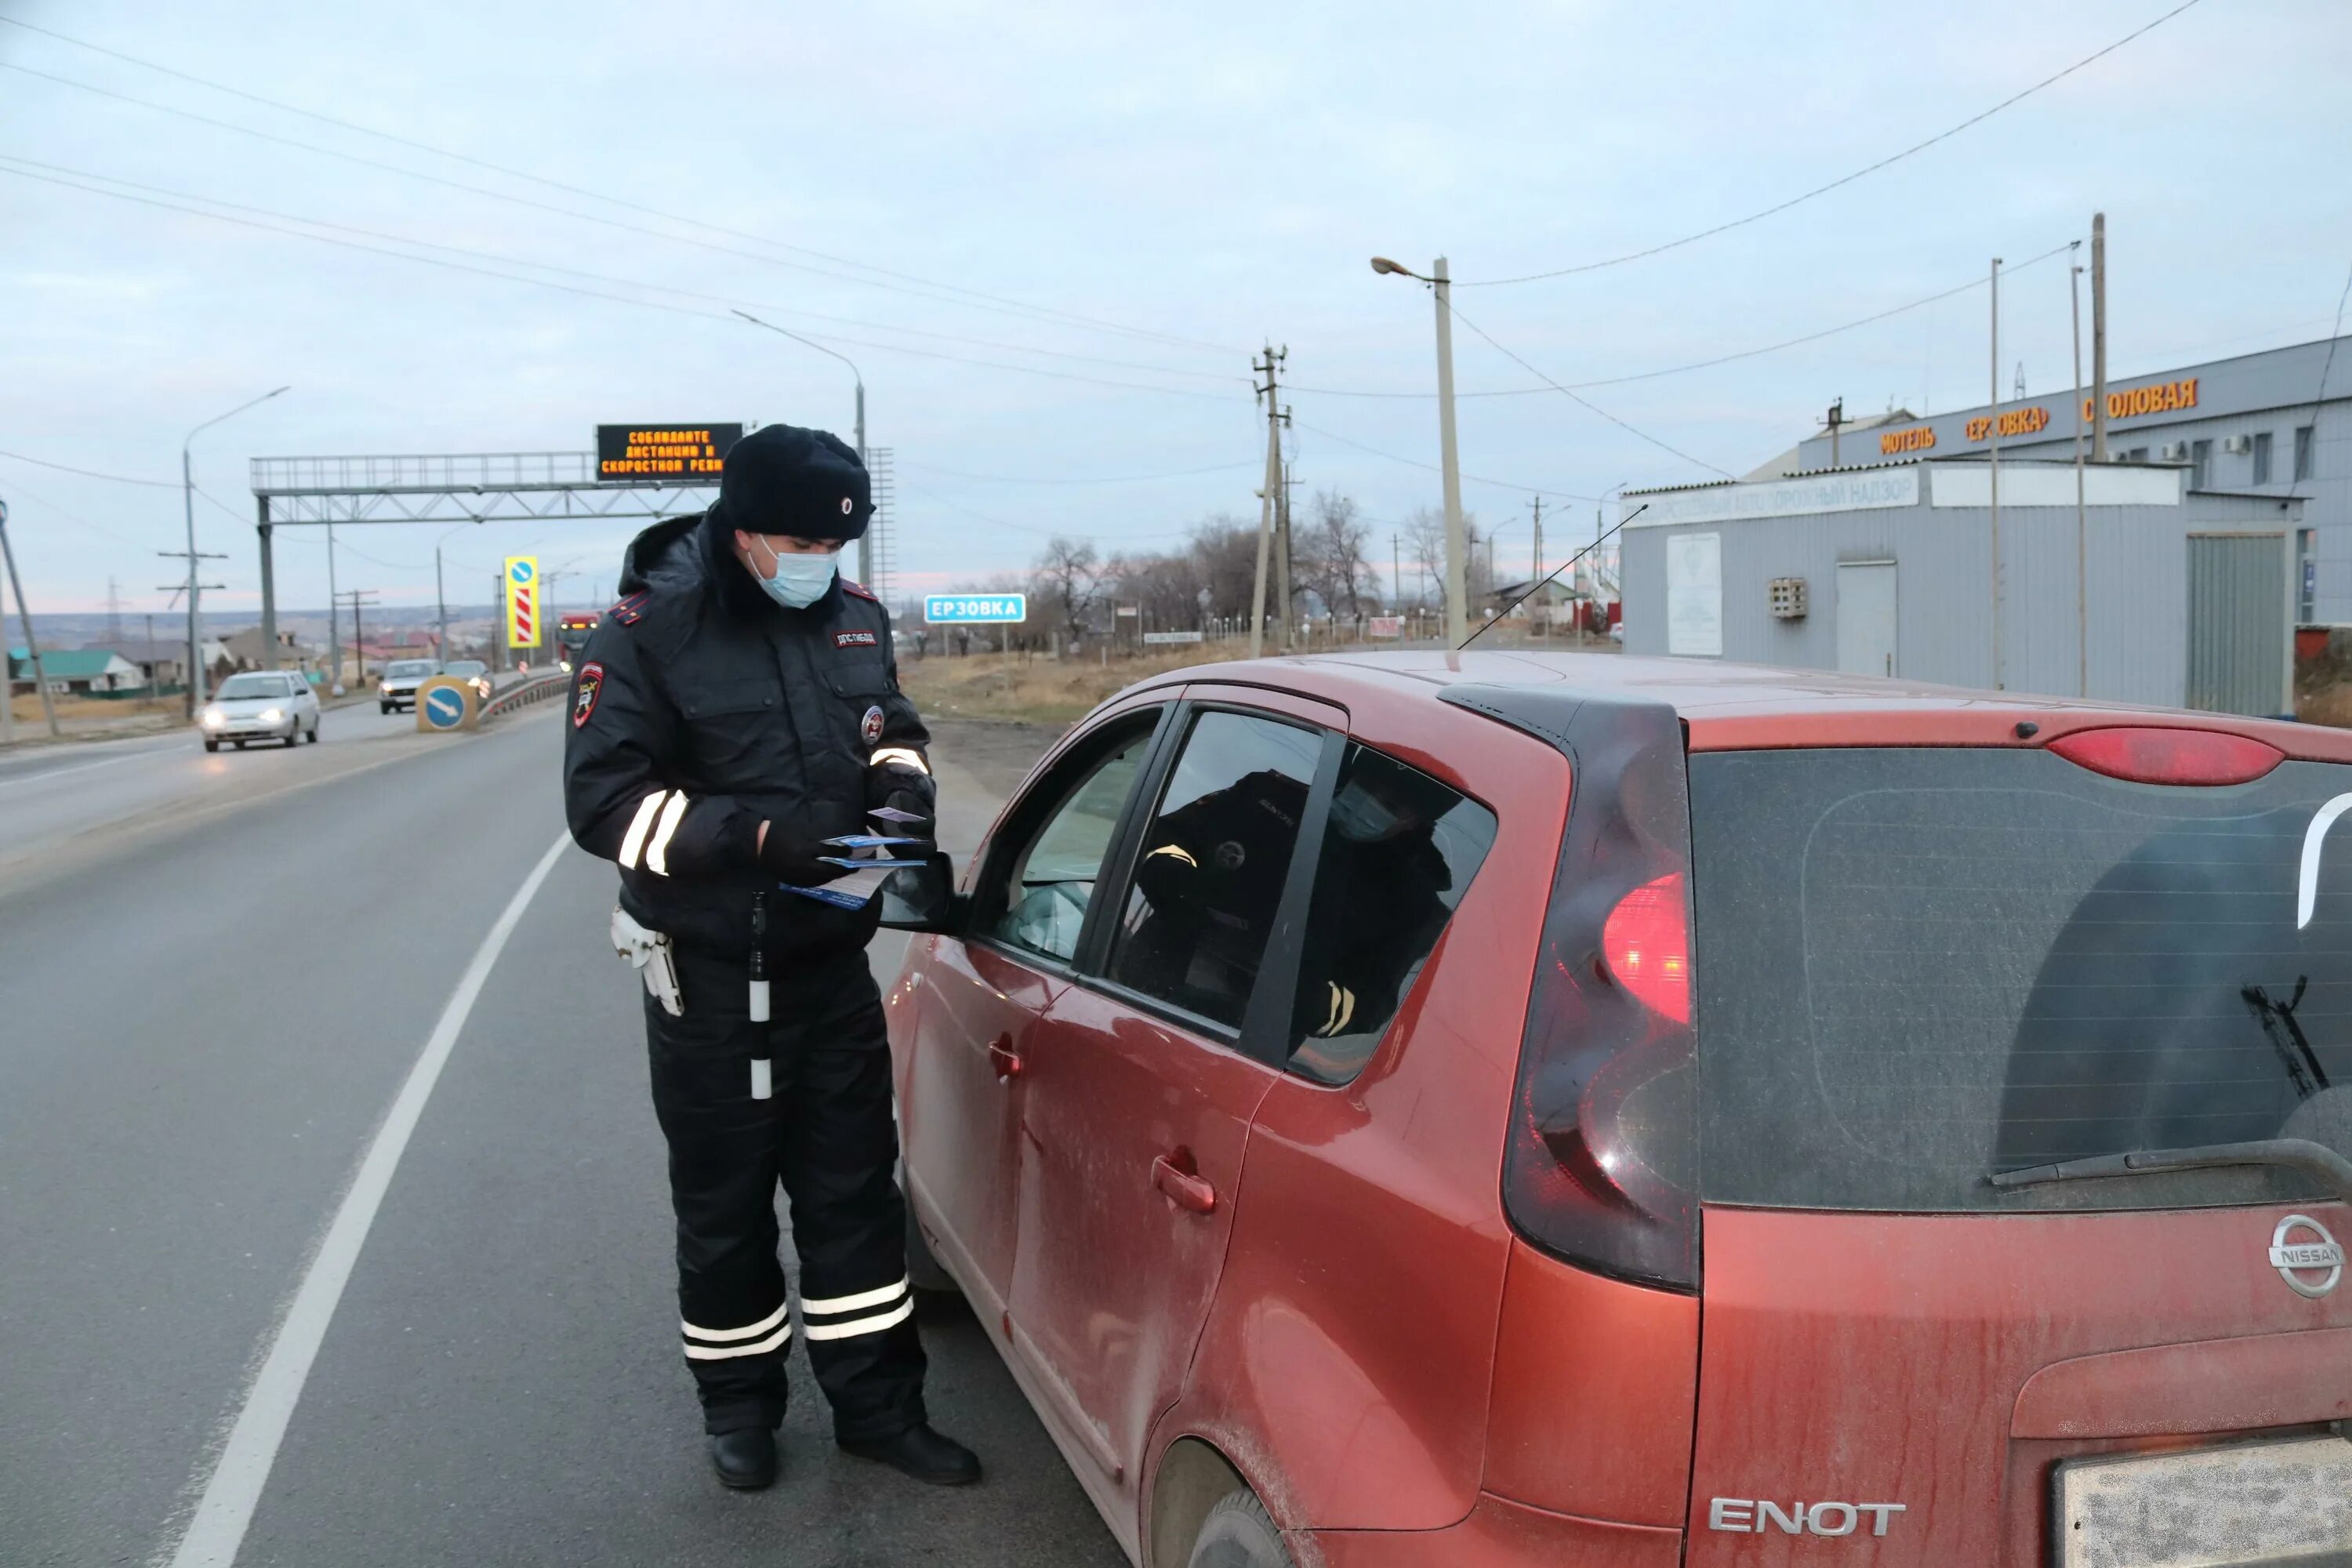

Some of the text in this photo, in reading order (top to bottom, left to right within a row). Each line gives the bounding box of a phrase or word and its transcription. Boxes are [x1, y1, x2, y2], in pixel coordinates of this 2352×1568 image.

[1880, 426, 1936, 455] МОТЕЛЬ
[2082, 377, 2198, 423] СОЛОВАЯ
[629, 430, 710, 444] СОБЛЮДАЙТЕ
[706, 445, 715, 457] И
[601, 459, 724, 473] СКОРОСТНОЙ РЕЖИ
[1849, 477, 1913, 504] НАДЗОР
[932, 601, 1018, 616] ЕРЗОВКА
[2281, 1248, 2340, 1264] NISSAN
[1708, 1497, 1907, 1537] ENOT
